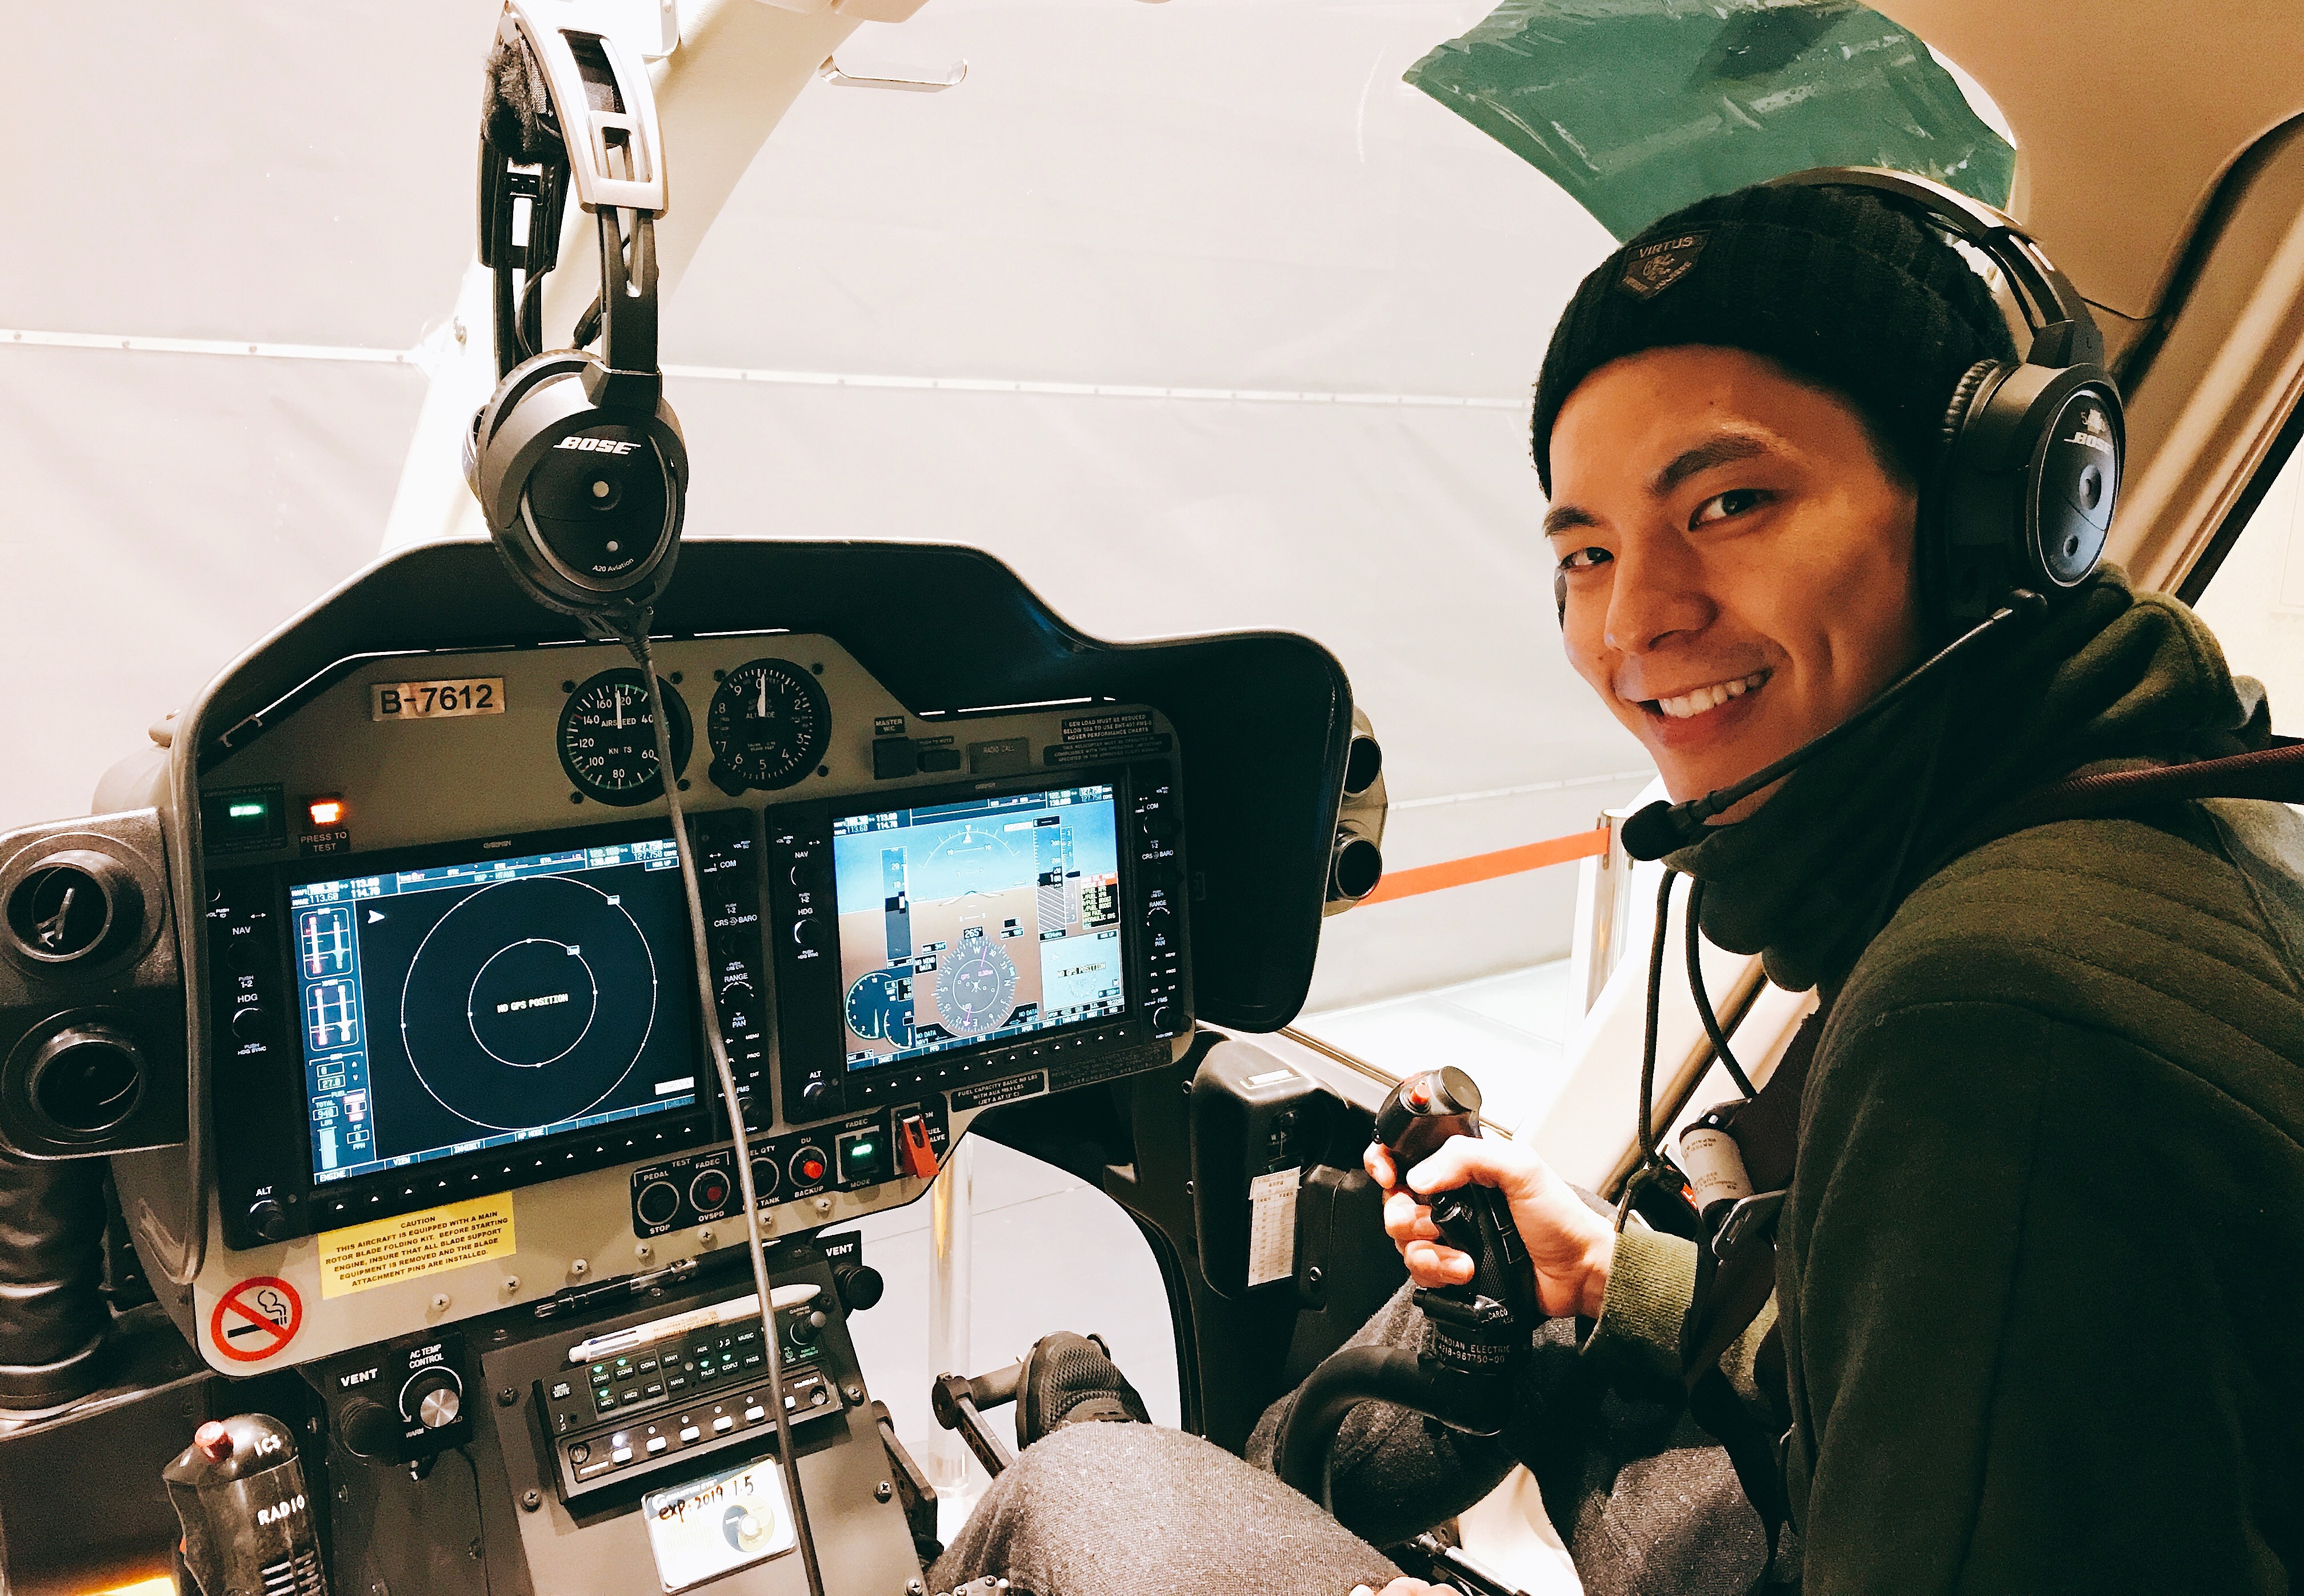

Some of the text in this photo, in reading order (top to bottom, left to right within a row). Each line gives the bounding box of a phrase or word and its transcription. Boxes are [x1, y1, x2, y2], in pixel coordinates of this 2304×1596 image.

[1640, 237, 1693, 258] VIRTUS
[553, 437, 641, 455] BOSE
[2064, 431, 2114, 455] BOSE
[607, 558, 634, 572] Aviation
[734, 686, 742, 696] 9
[782, 683, 784, 694] 1
[381, 684, 494, 714] B-7612
[597, 699, 612, 709] 160
[794, 699, 801, 710] 2
[719, 703, 725, 713] 8
[583, 715, 599, 725] 140
[601, 717, 637, 727] AIRSEED
[641, 714, 654, 723] 40
[797, 733, 803, 744] 3
[1087, 730, 1126, 738] PERFORMANCE
[579, 738, 594, 748] 120
[721, 741, 726, 752] 7
[642, 750, 654, 758] 60
[735, 753, 743, 764] 6
[782, 749, 789, 758] 4
[589, 757, 604, 766] 100
[759, 759, 766, 770] 5
[613, 769, 625, 778] 80
[301, 832, 347, 844] PRESS TO
[313, 843, 336, 852] TEST
[483, 841, 511, 849] GARMIN
[720, 860, 737, 869] COM
[1149, 899, 1167, 908] RANGE
[798, 907, 813, 915] HDG
[714, 914, 757, 927] CRS BARO
[232, 926, 251, 935] NAV
[989, 949, 997, 957] 30
[724, 973, 749, 982] RANGE
[237, 993, 258, 1003] HDG
[497, 993, 569, 1013] NO GPS POSITION
[732, 1019, 746, 1028] PAN
[809, 1070, 822, 1079] ALT
[974, 1083, 1001, 1093] CAPACITY
[315, 1100, 335, 1108] TOTAL
[846, 1118, 868, 1129] FADEC
[760, 1145, 775, 1154] QTY
[671, 1158, 691, 1167] TEST
[643, 1158, 721, 1181] PEDAL FADEC
[319, 1170, 346, 1182] ENGINE
[255, 1186, 273, 1197] ALT
[794, 1185, 824, 1198] BACKUP
[760, 1197, 780, 1207] TANK
[400, 1216, 436, 1229] CAUTION
[650, 1210, 725, 1234] STOP OVSPD
[336, 1244, 355, 1253] THIS
[358, 1234, 396, 1248] AIRCRAFT
[409, 1222, 447, 1236] EQUIPPED
[449, 1218, 469, 1226] WITH
[478, 1211, 498, 1220] MAIN
[326, 1217, 508, 1265] ROTOR BLADE FOLDING KIT. BEFORE STARTING
[334, 1260, 367, 1271] ENGINE,
[370, 1251, 399, 1263] INSURE
[402, 1247, 421, 1255] THAT
[441, 1237, 465, 1247] BLADE
[468, 1228, 502, 1240] SUPPORT
[825, 1243, 853, 1257] VENT
[340, 1263, 386, 1280] EQUIPMENT
[399, 1253, 436, 1266] REMOVED
[439, 1249, 454, 1257] AND
[457, 1245, 472, 1253] THE
[474, 1238, 498, 1249] BLADE
[352, 1250, 489, 1286] ATTACHMENT PINS ARE INSTALLED.
[738, 1332, 754, 1341] MUSIC
[409, 1343, 442, 1360] AC TEMP
[1471, 1344, 1511, 1354] ELECTRIC
[409, 1353, 443, 1369] CONTROL
[593, 1354, 678, 1383] COM1 COM2 COM3 NAV1
[701, 1368, 715, 1377] PILOT
[340, 1368, 378, 1387] VENT
[553, 1389, 570, 1398] MUTE
[600, 1398, 614, 1407] MIC1
[624, 1391, 638, 1399] MIC2
[253, 1434, 282, 1457] ICS
[257, 1494, 305, 1526] RADIO
